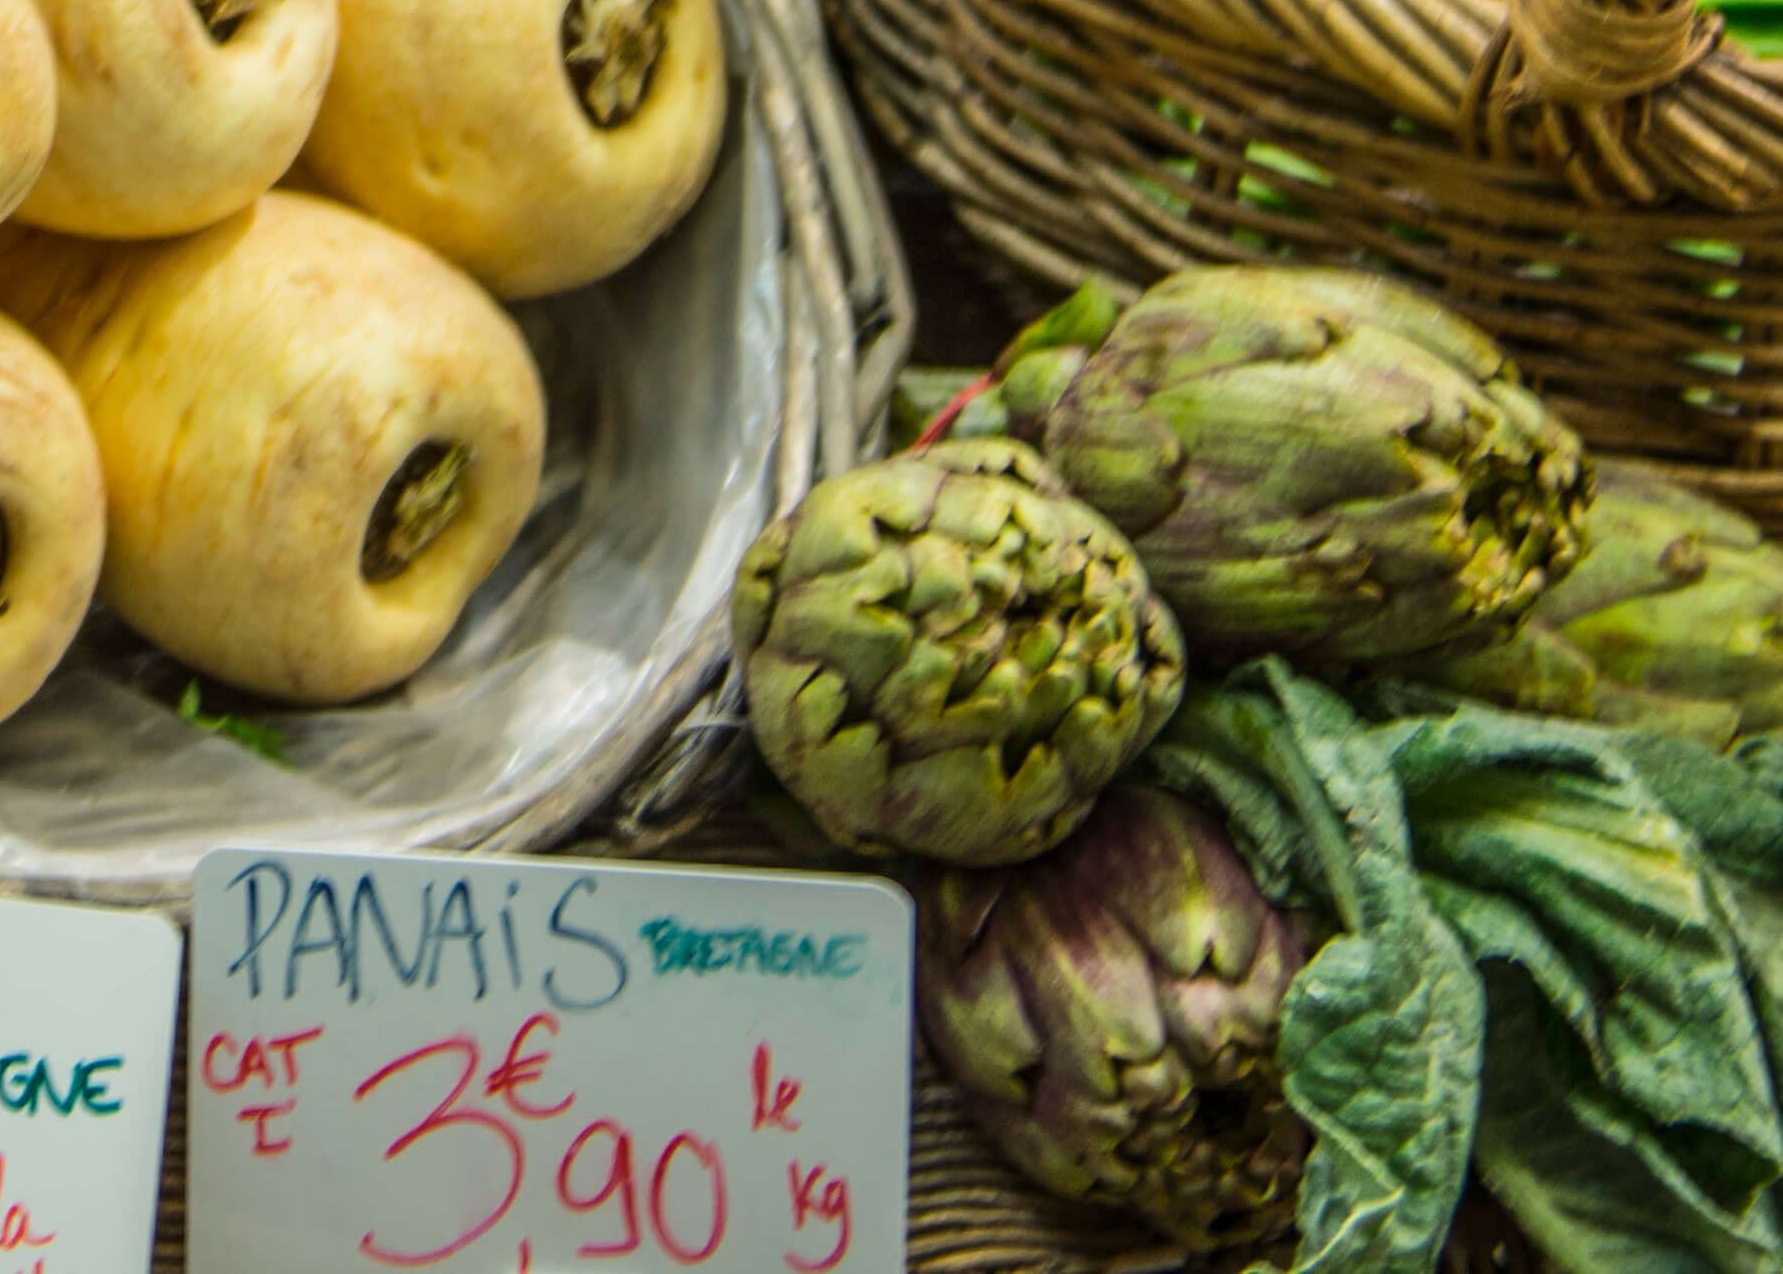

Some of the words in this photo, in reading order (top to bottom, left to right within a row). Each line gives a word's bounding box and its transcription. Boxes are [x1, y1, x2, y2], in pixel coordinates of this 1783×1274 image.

[226, 859, 629, 1011] PANAIS
[637, 914, 869, 979] BRETAGNE
[202, 1025, 325, 1094] CAT
[751, 1041, 804, 1133] le
[237, 1099, 297, 1158] I
